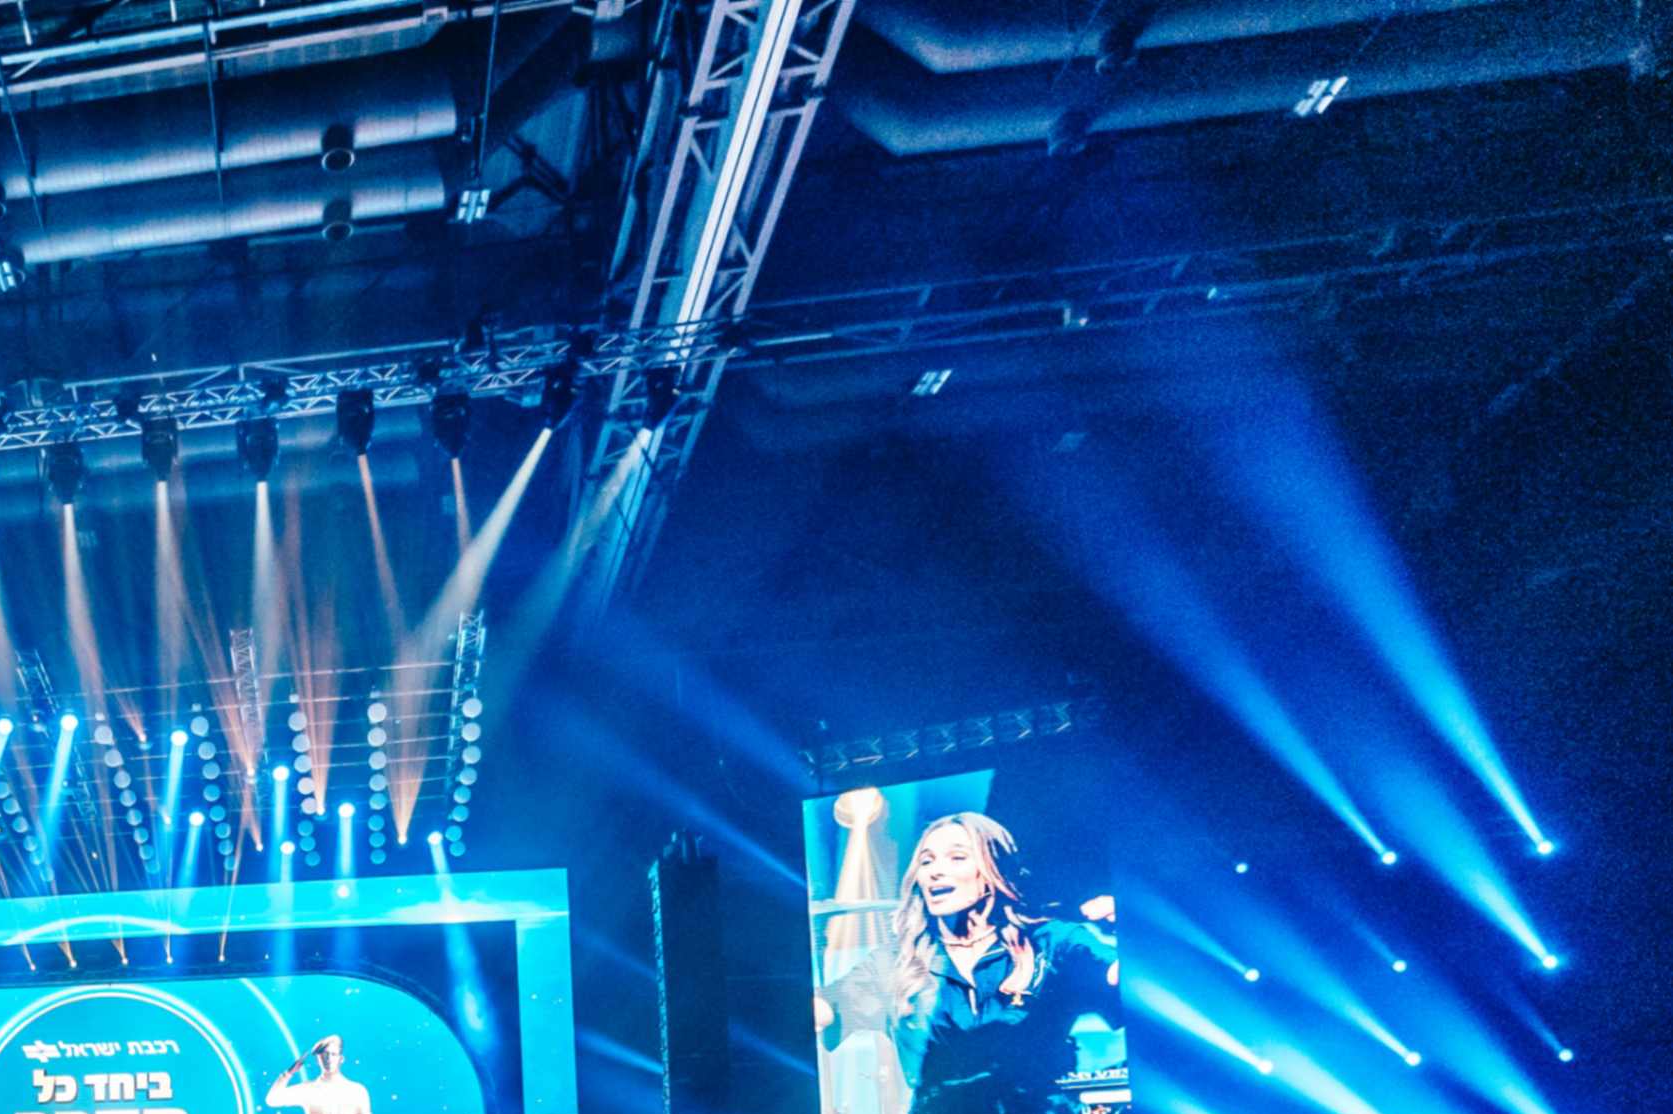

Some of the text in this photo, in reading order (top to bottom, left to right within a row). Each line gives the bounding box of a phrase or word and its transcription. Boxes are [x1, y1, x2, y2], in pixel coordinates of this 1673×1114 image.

[58, 1039, 180, 1058] רכבת ישראל
[33, 1069, 173, 1103] ביחד כל
